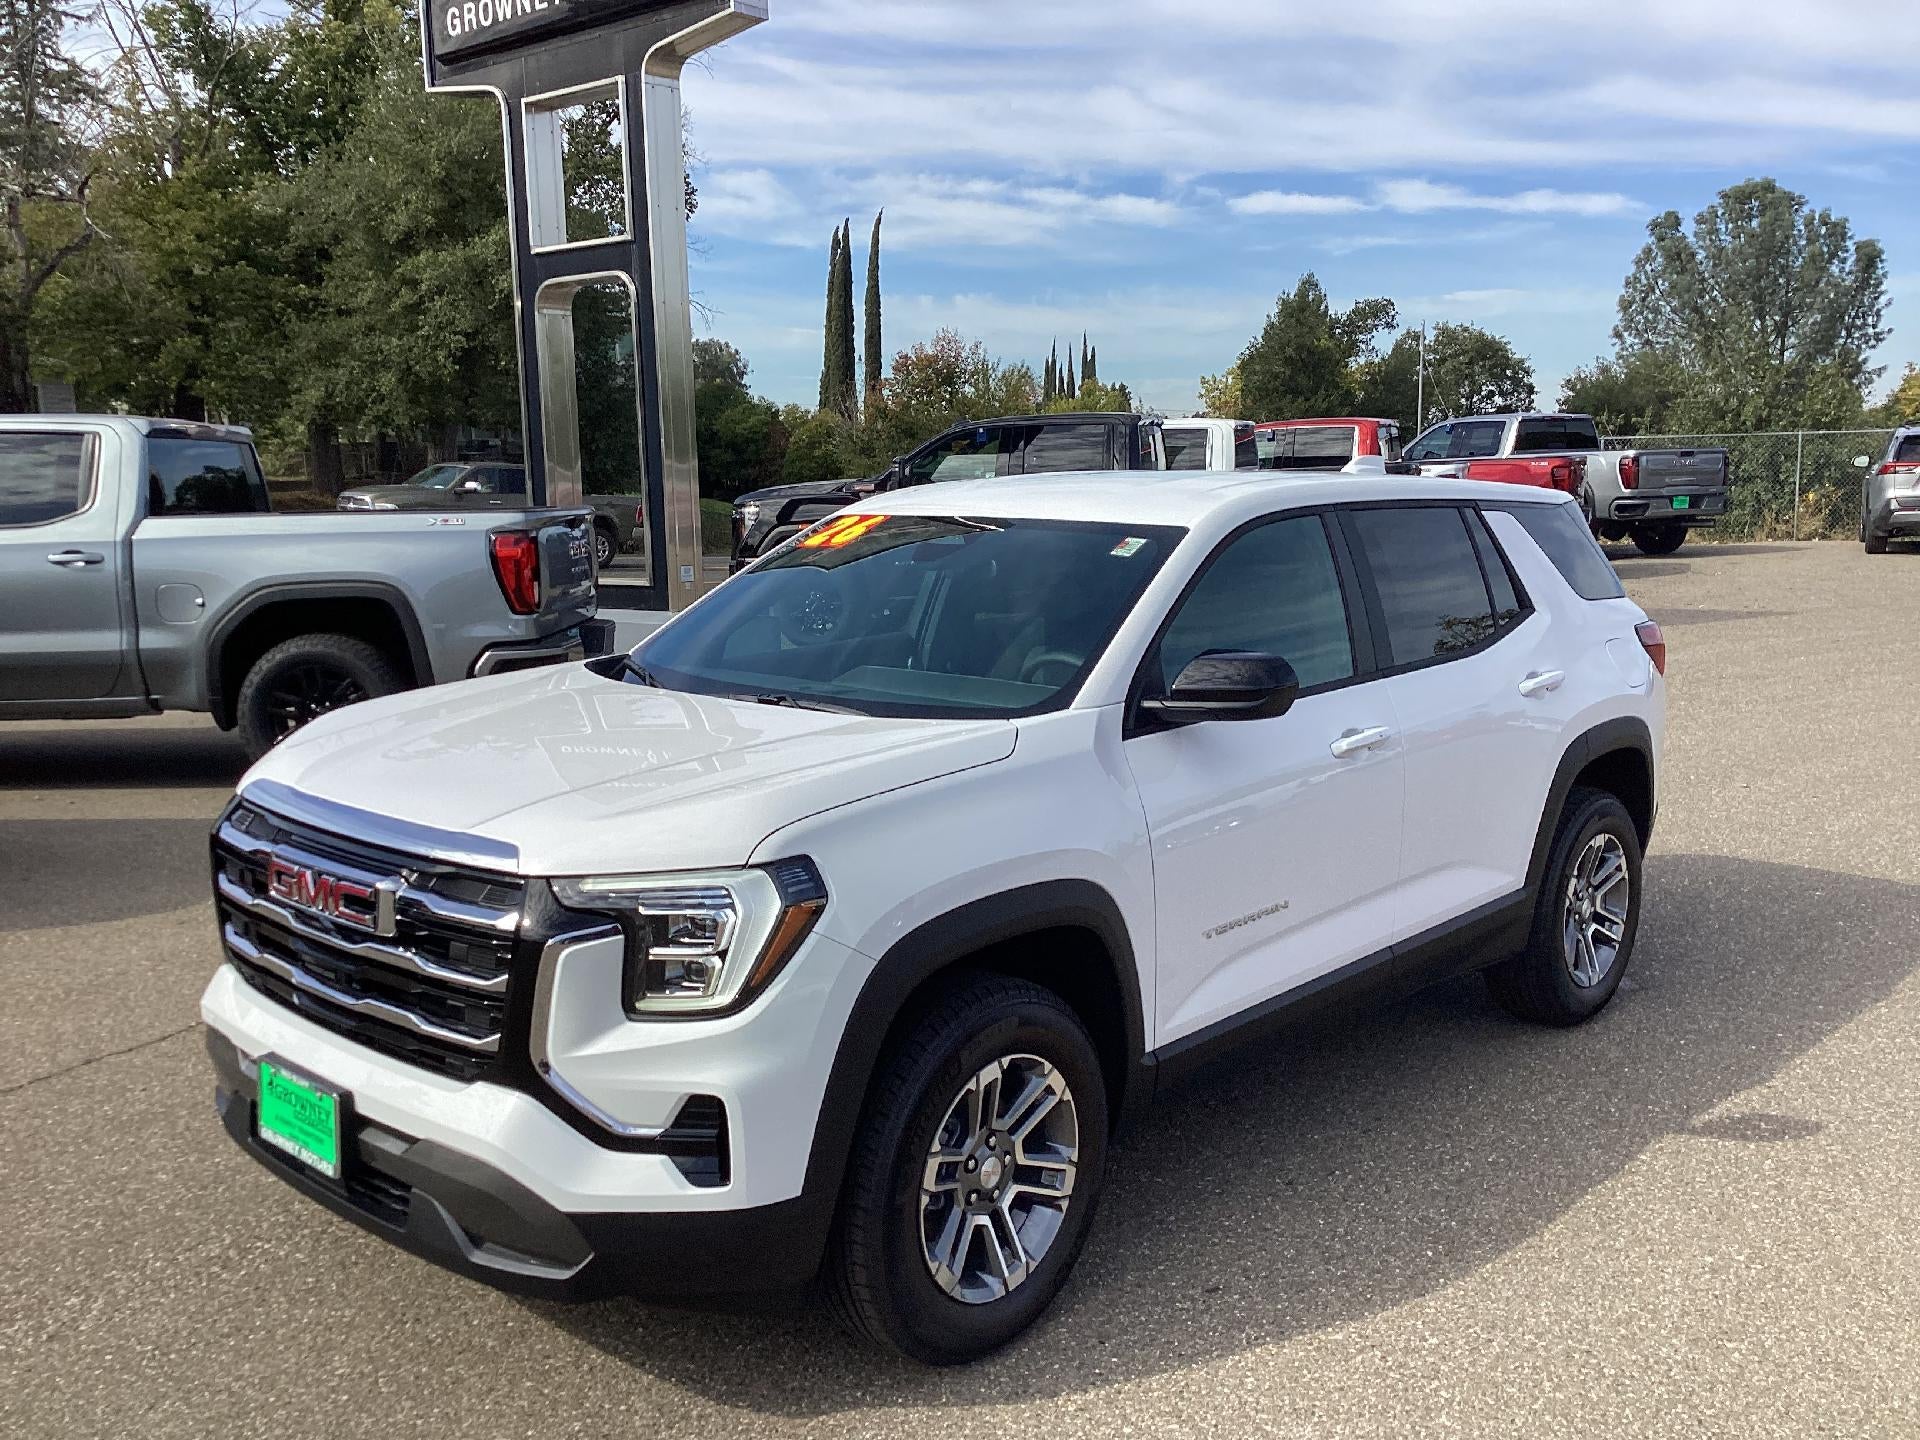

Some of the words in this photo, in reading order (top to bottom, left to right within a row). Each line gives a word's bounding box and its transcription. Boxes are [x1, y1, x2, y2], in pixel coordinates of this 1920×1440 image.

[446, 0, 561, 37] GROWN
[268, 857, 375, 929] GMC
[1201, 900, 1290, 939] TERRAIN
